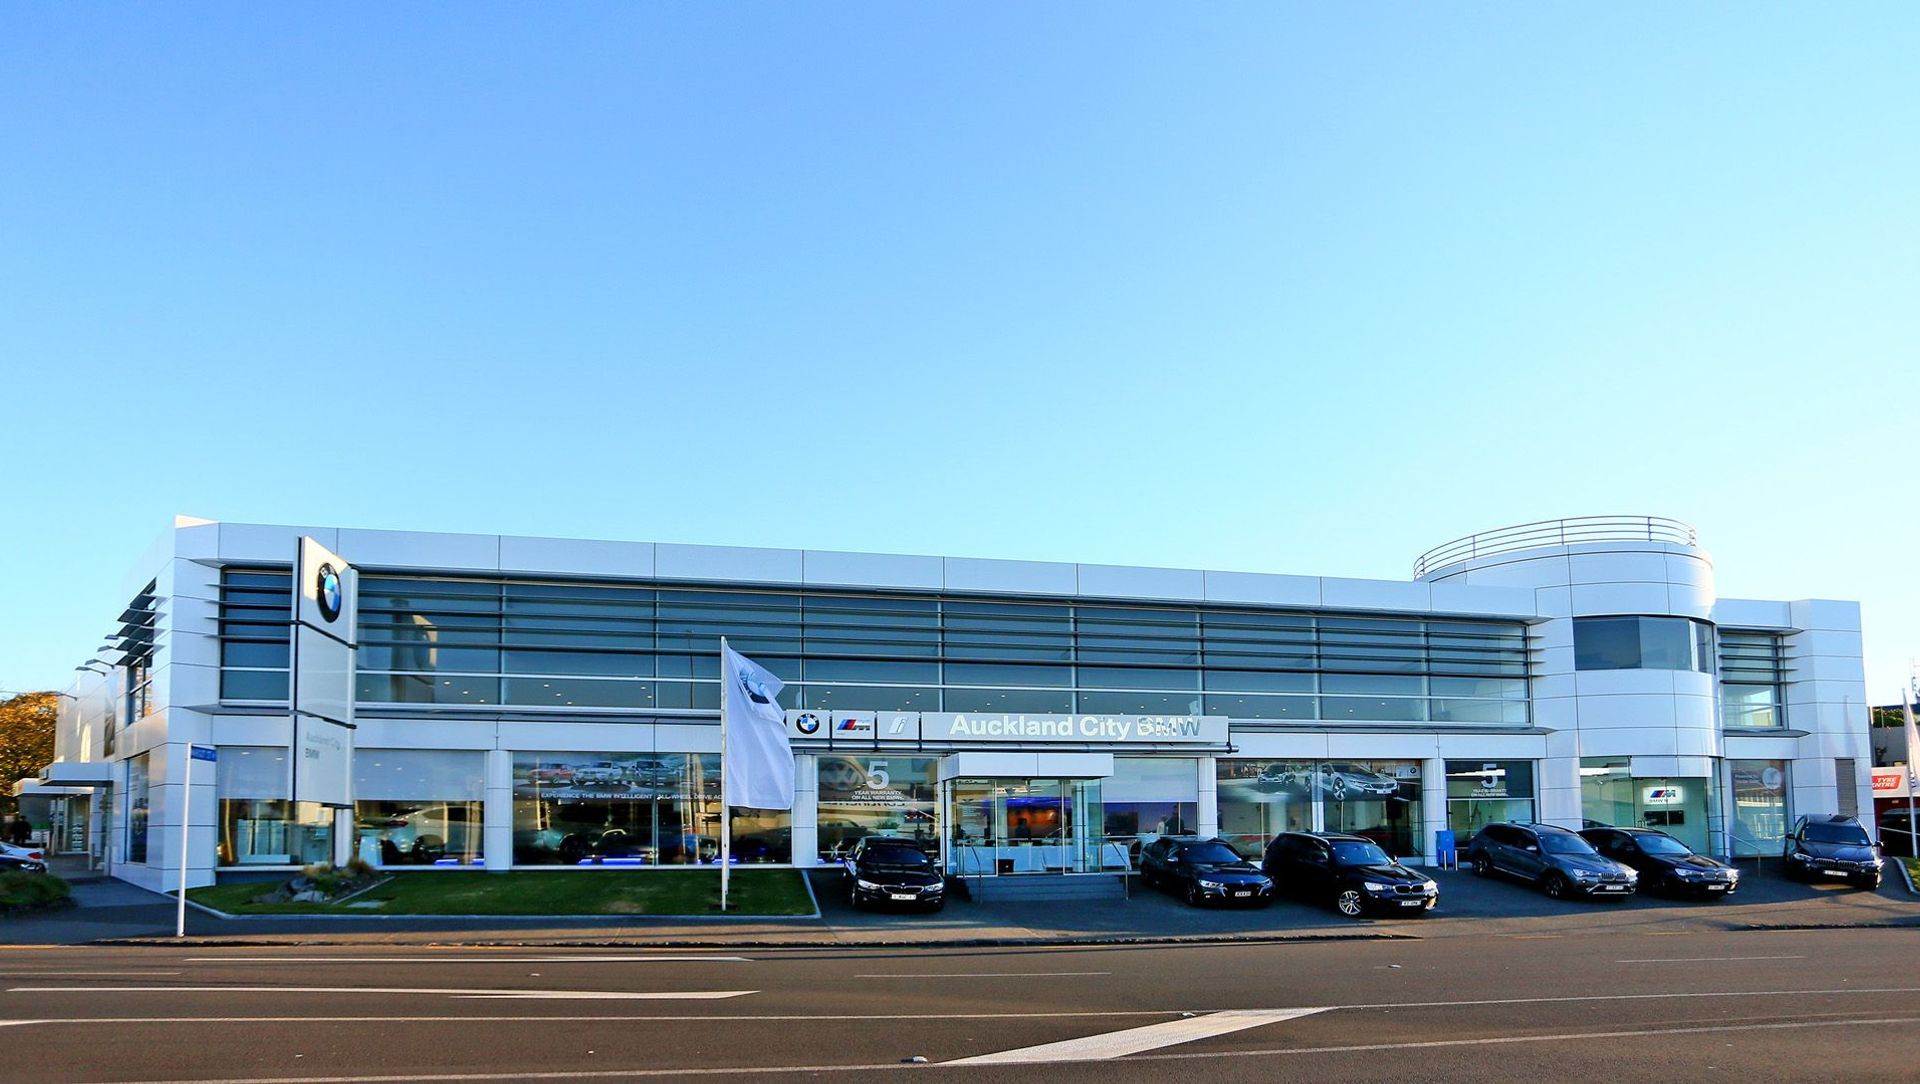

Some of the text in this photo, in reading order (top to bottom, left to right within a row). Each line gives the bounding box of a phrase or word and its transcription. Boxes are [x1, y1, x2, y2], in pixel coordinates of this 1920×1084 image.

[949, 714, 1200, 741] Auckland City BMW
[866, 761, 890, 790] 5
[1481, 763, 1499, 788] 5
